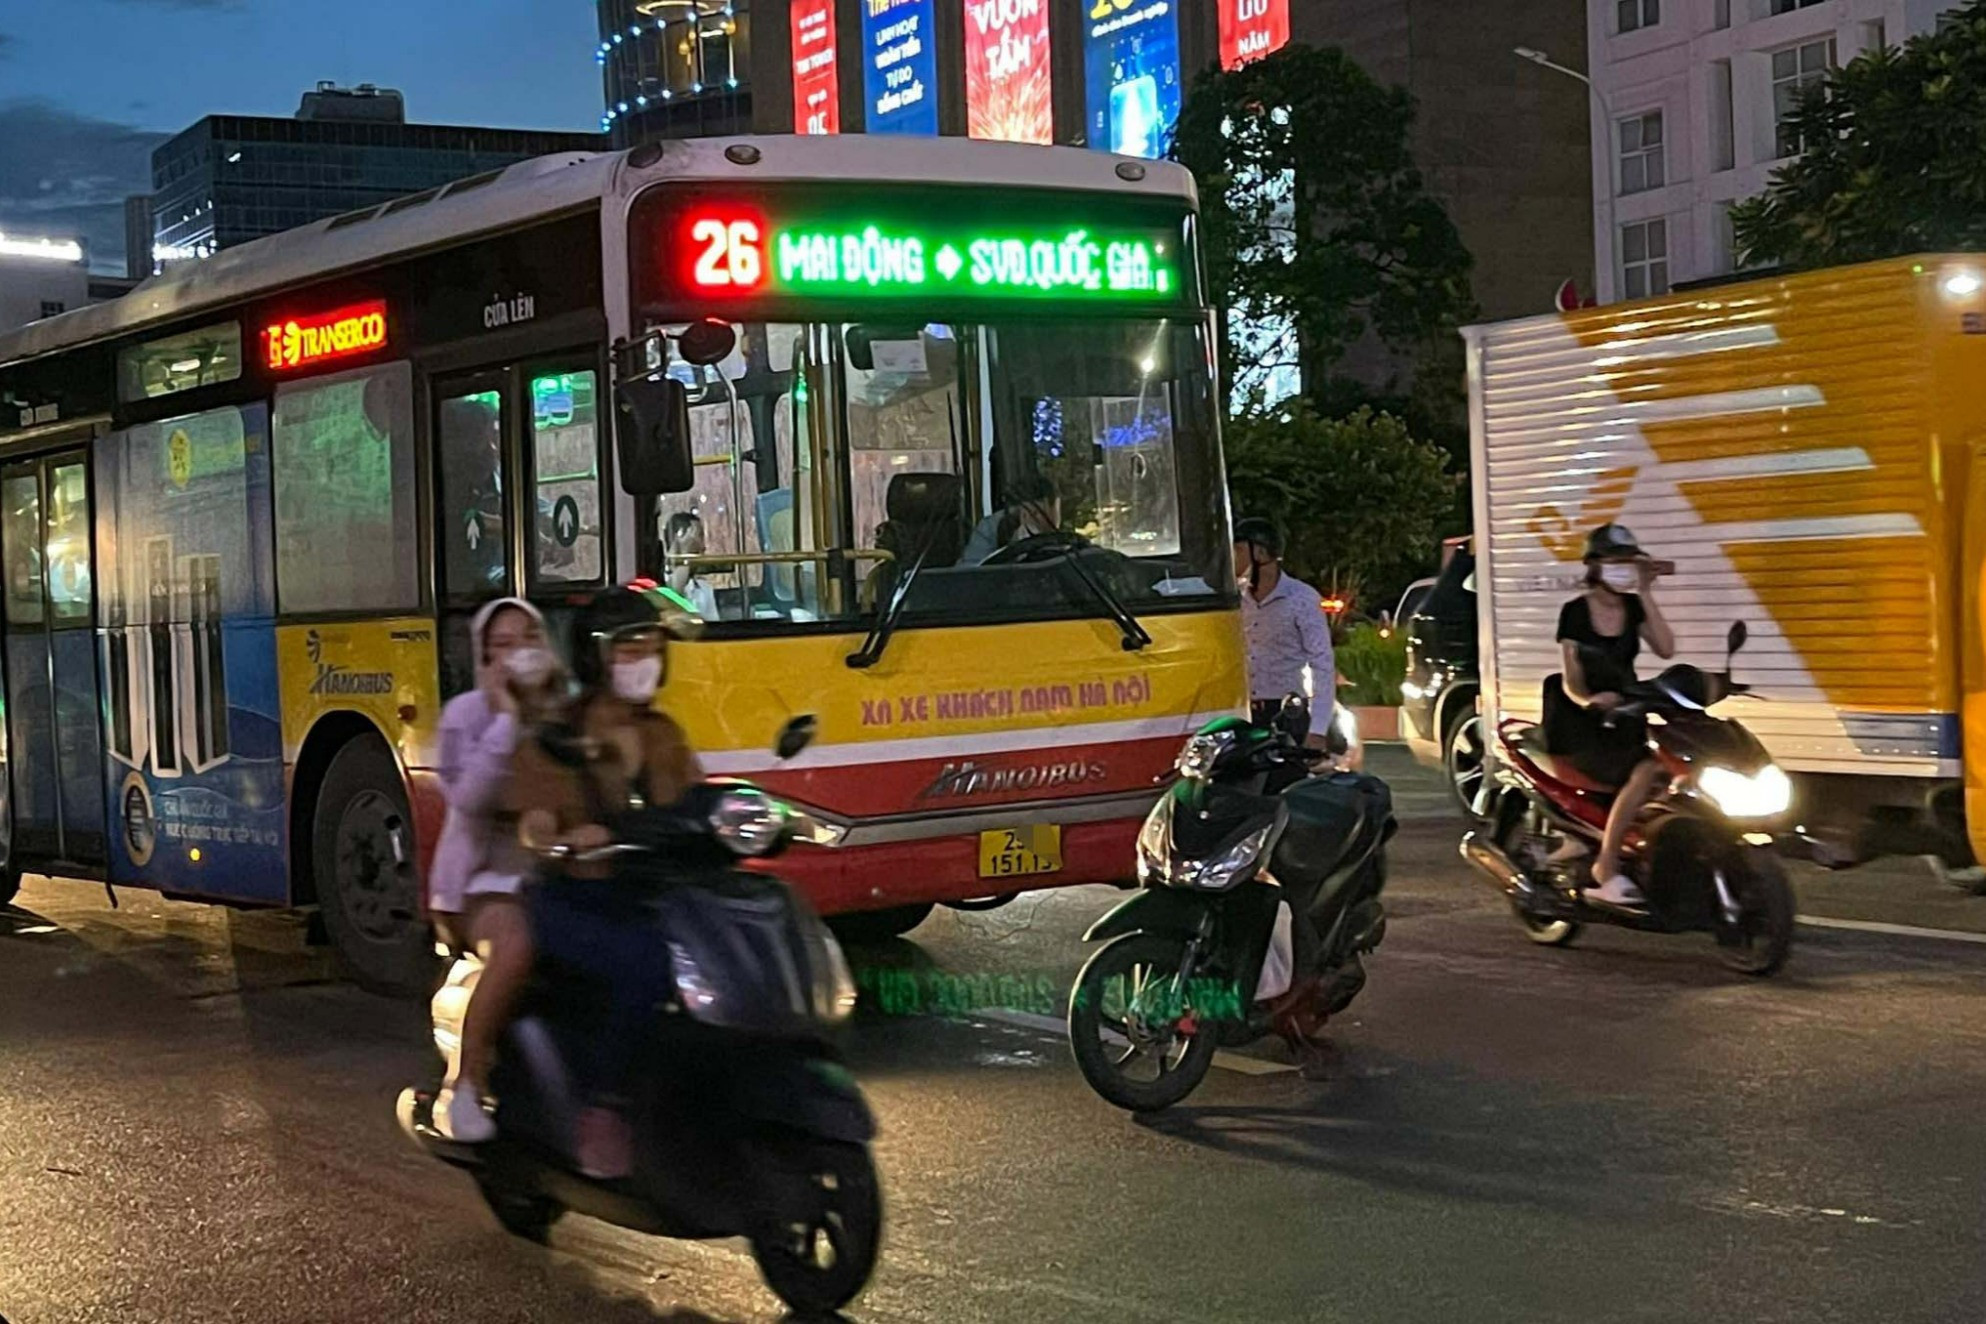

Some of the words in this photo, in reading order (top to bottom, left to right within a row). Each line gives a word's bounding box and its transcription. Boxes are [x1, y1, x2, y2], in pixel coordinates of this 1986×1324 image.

[691, 219, 761, 286] 26
[779, 232, 839, 282] MAI
[510, 291, 535, 322] LÊN
[899, 694, 929, 723] XE
[936, 687, 1014, 721] KHÁCH
